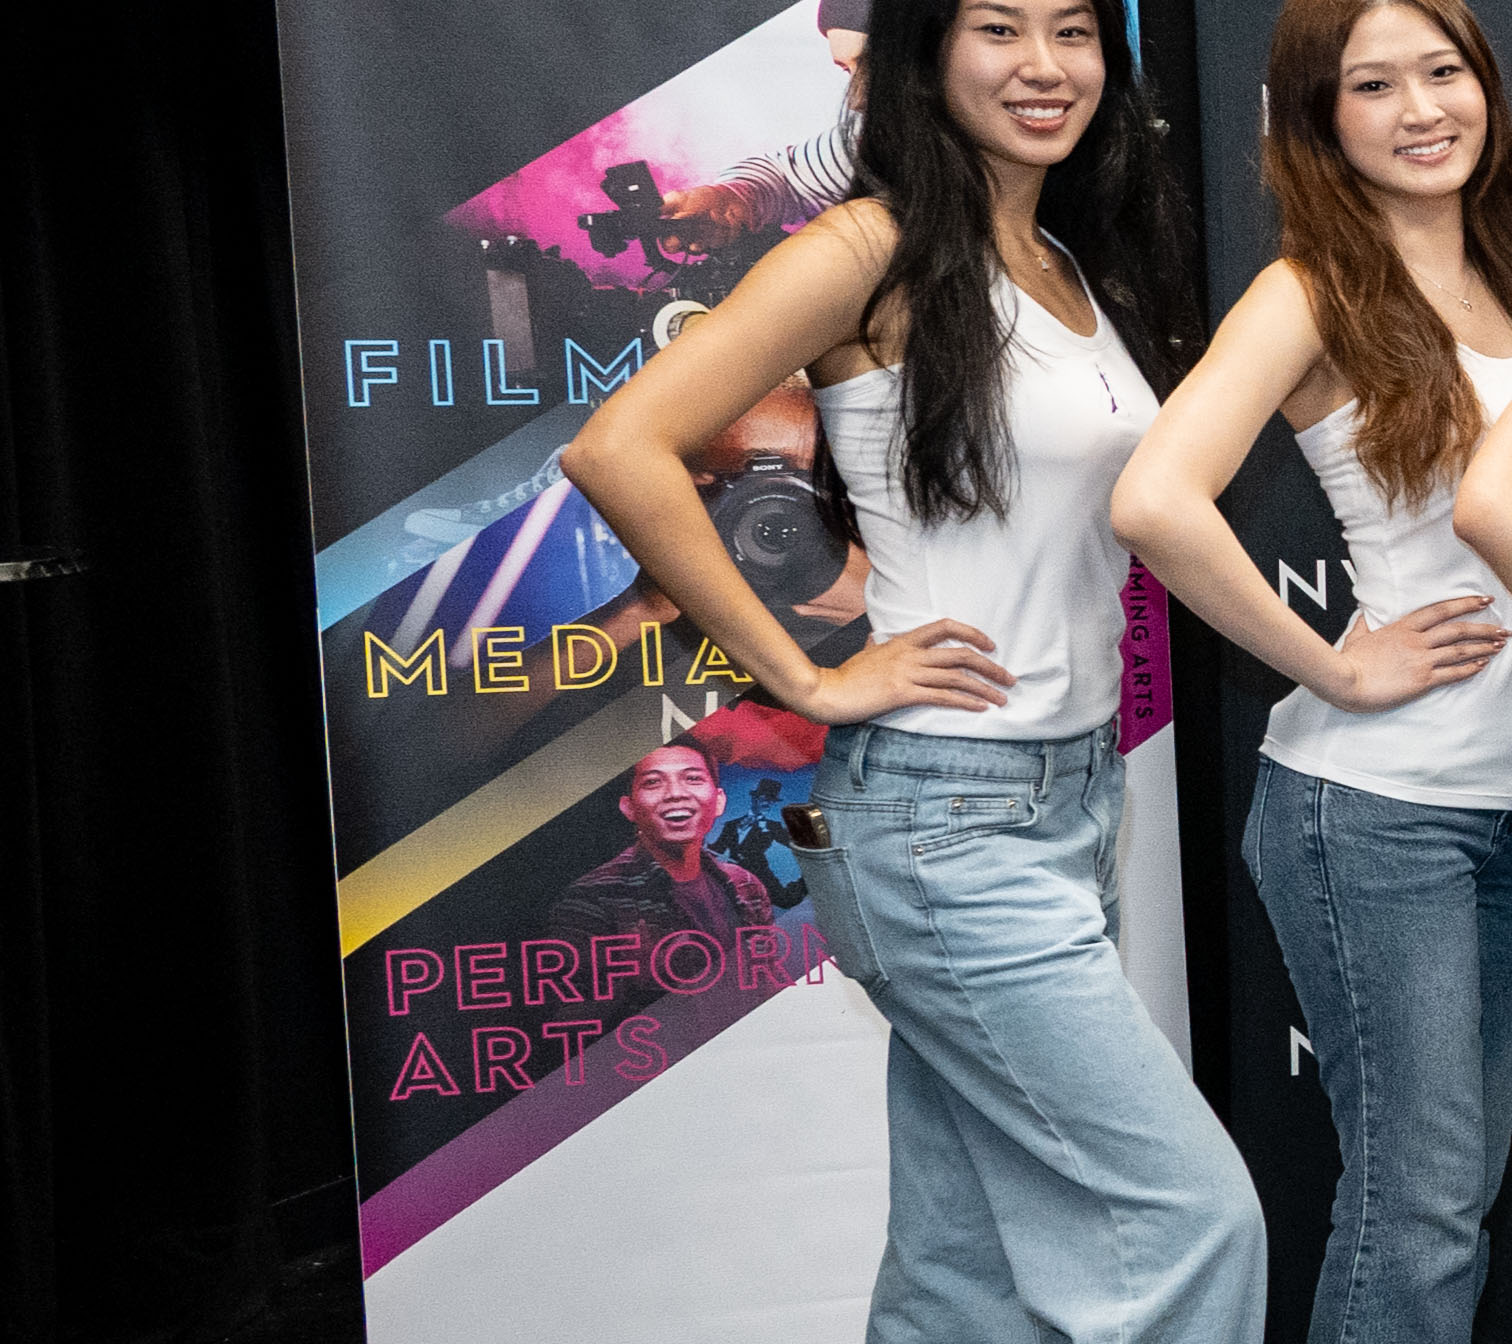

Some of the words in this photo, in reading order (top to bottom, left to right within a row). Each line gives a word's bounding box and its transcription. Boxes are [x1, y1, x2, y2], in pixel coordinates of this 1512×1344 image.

[344, 337, 643, 407] FILM
[363, 621, 753, 699] MEDIA
[1132, 653, 1155, 720] ARTS
[385, 922, 838, 1017] PERFOR
[389, 1014, 670, 1102] ARTS
